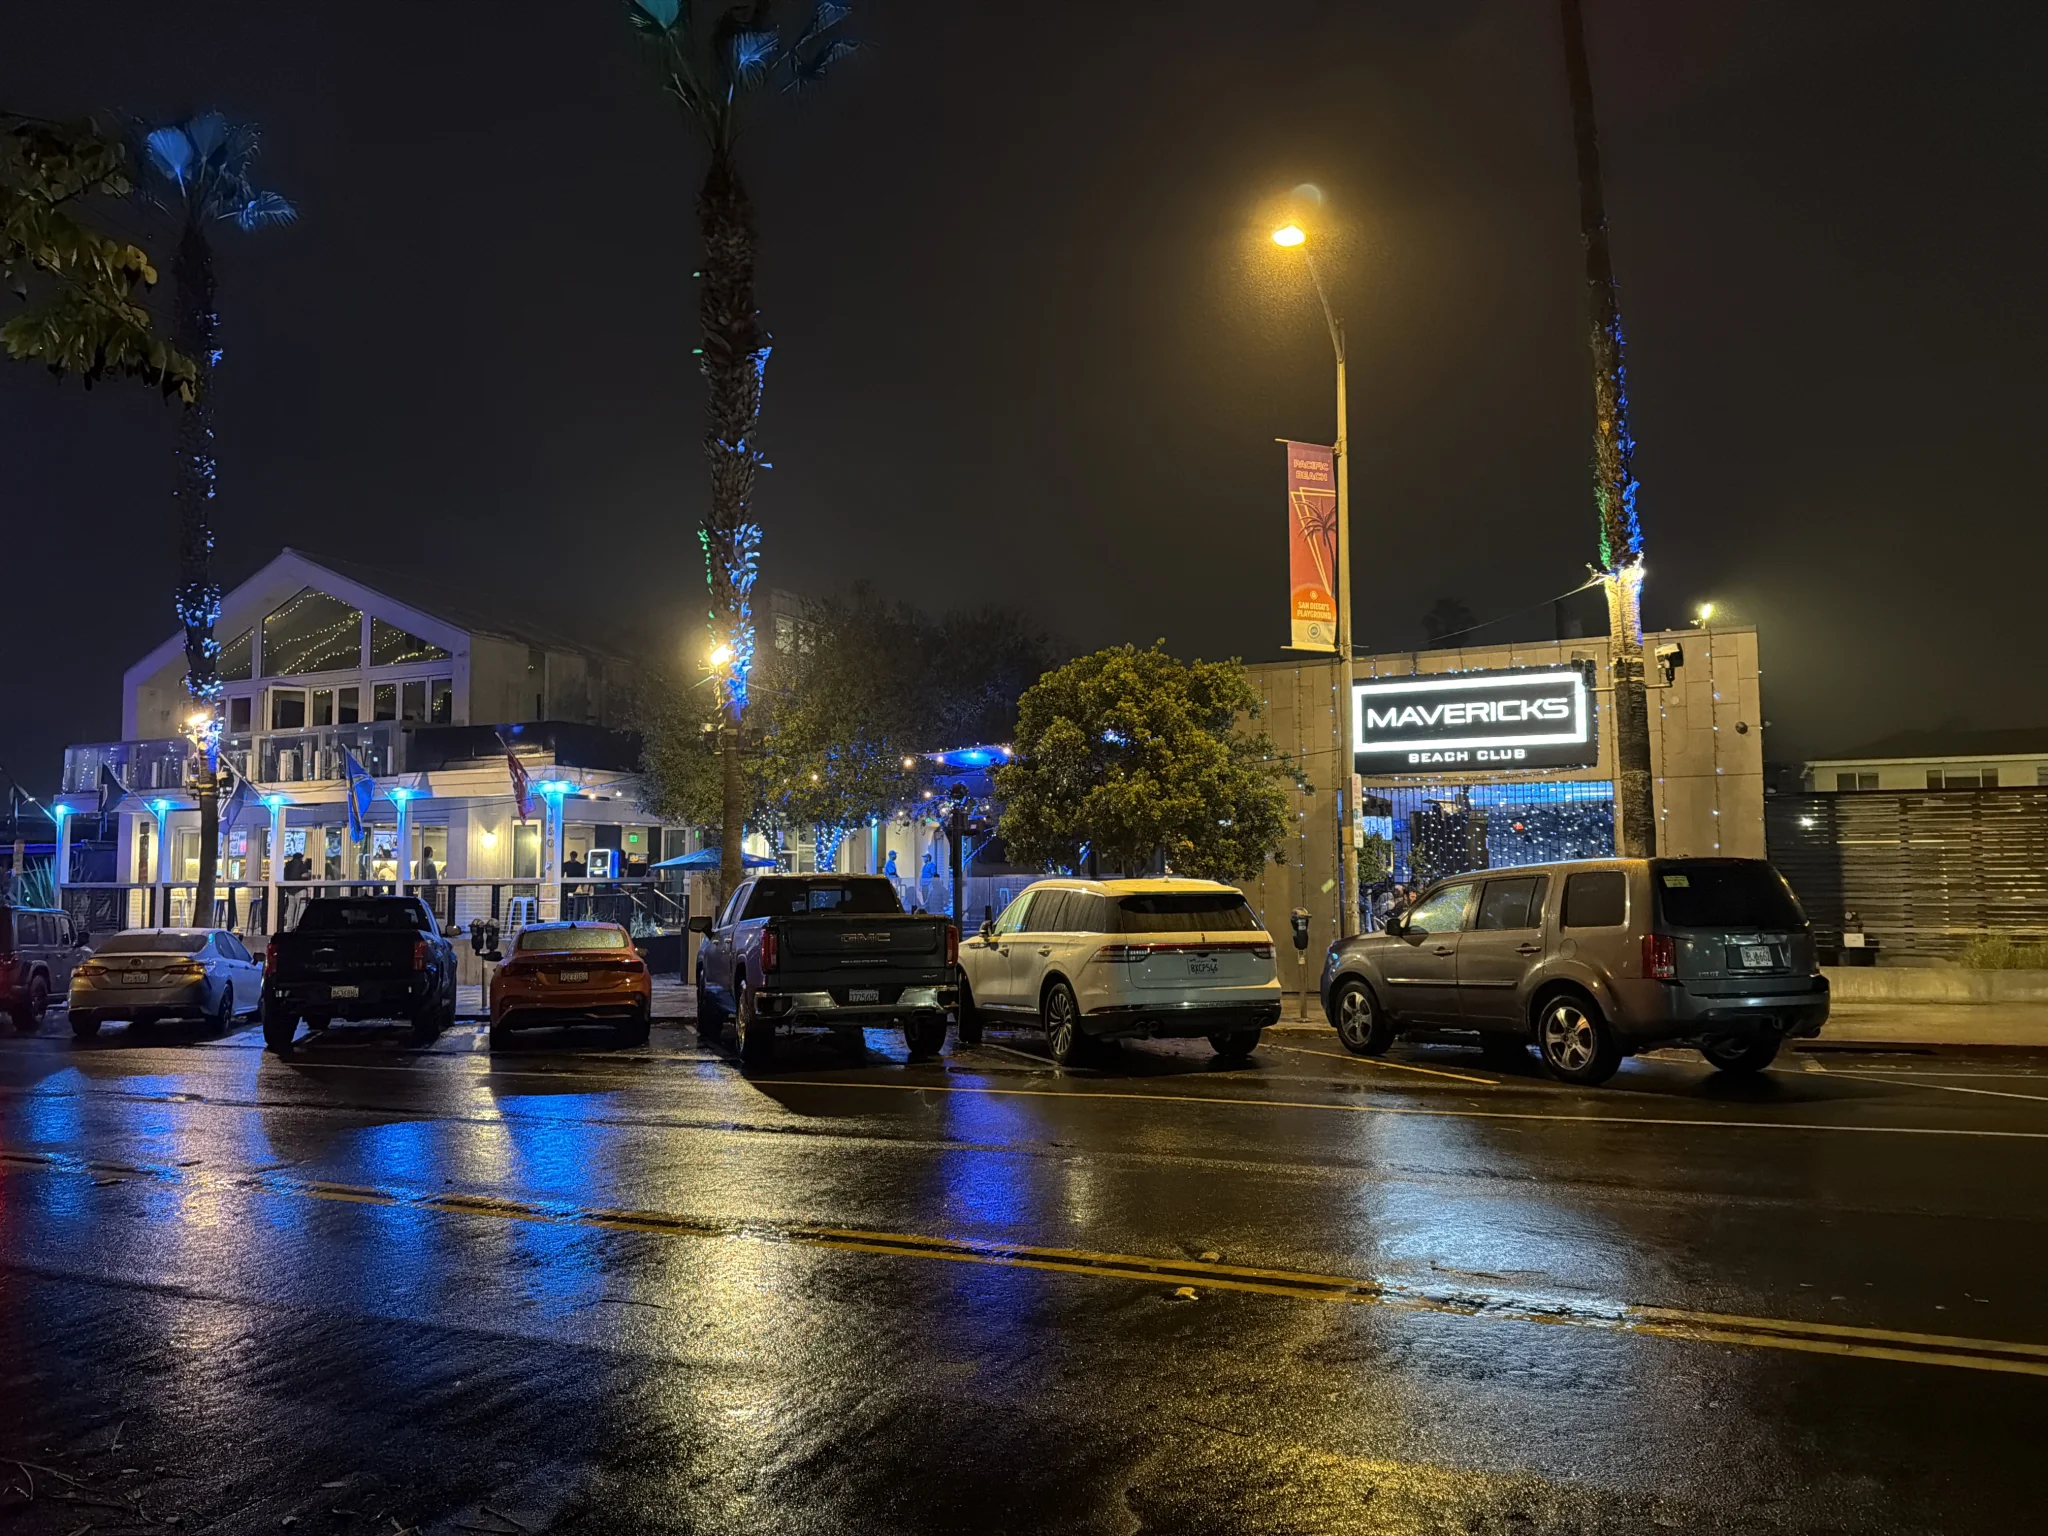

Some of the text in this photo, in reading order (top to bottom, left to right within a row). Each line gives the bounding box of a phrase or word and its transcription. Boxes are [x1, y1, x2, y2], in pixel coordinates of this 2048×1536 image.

[1293, 458, 1329, 470] PACIFIC
[1295, 470, 1328, 481] BEACH
[1297, 601, 1330, 611] SAN DIEGO'S
[1297, 609, 1331, 619] PLAYGROUND
[1366, 697, 1569, 728] MAVERICKS
[1408, 748, 1527, 764] BEACH CLUB
[840, 932, 891, 943] GMC
[1190, 963, 1219, 974] 8XCP546
